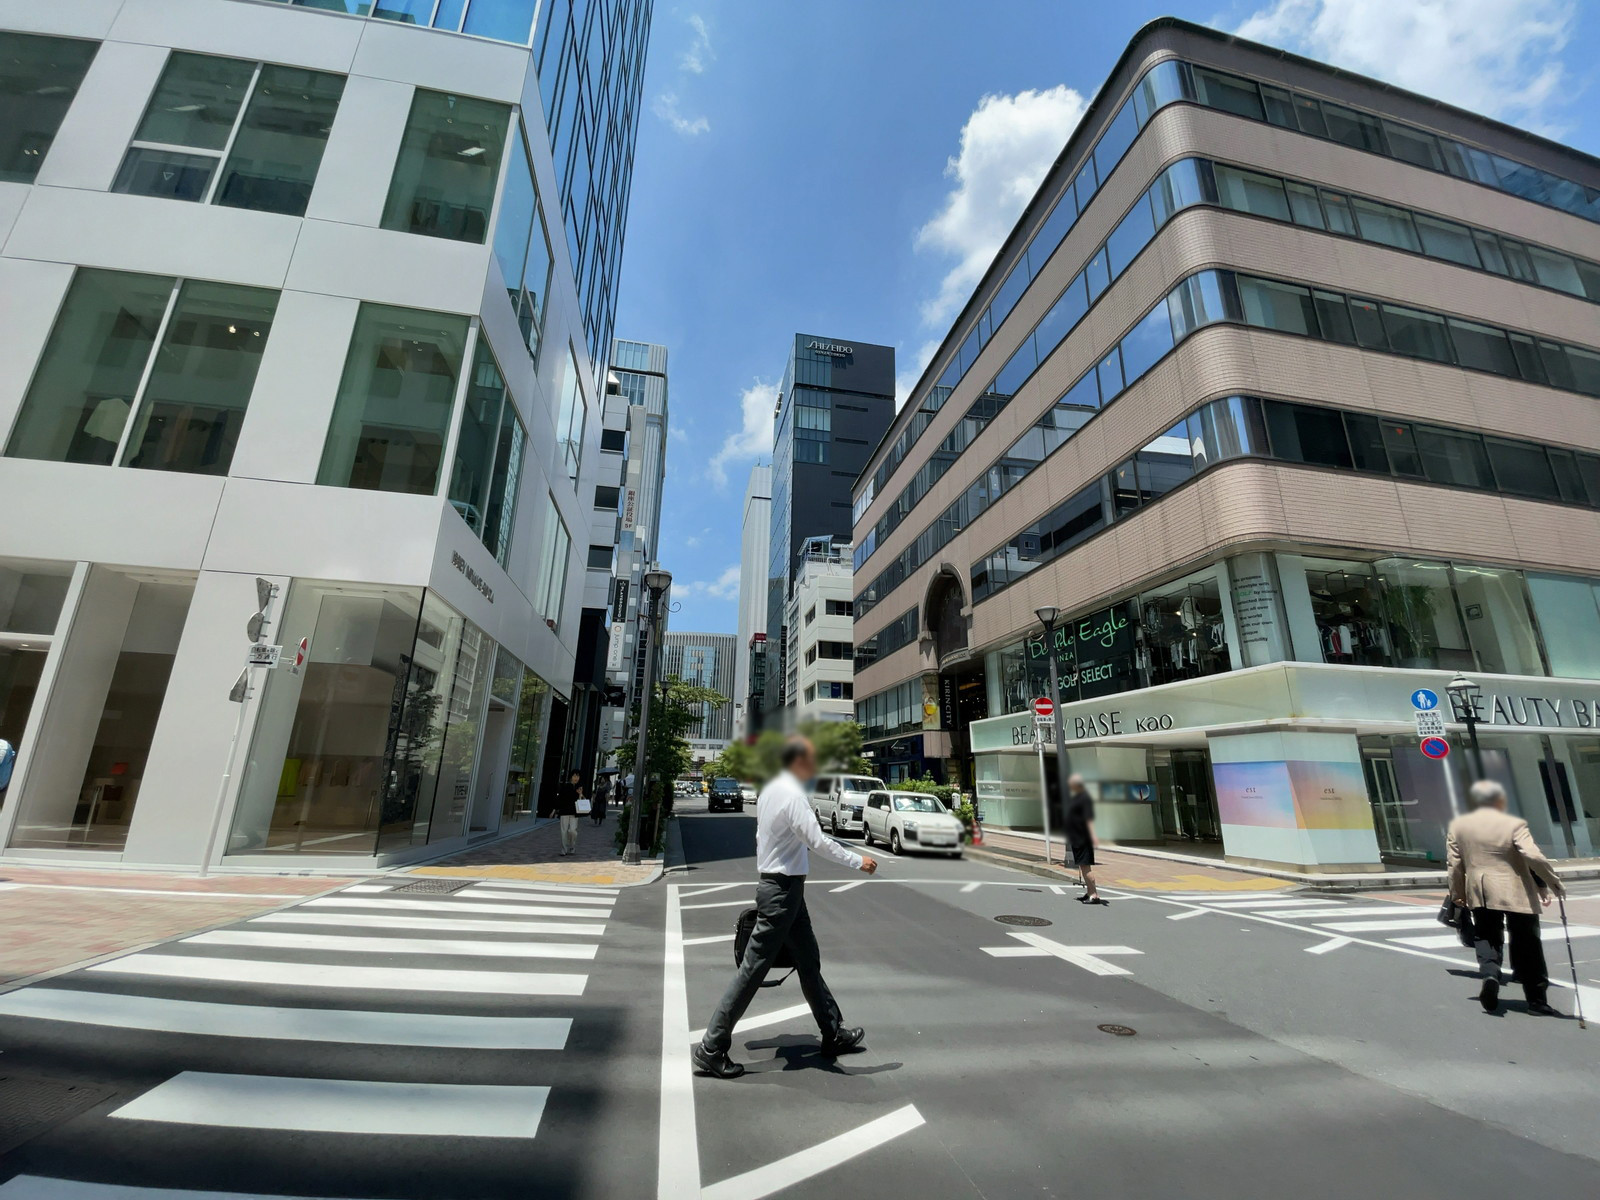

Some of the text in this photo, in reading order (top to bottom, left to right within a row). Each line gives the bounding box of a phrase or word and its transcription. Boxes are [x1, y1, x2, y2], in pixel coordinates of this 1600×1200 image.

[807, 341, 853, 354] SHISEIDO
[1030, 608, 1129, 658] Doble Eagle
[1056, 652, 1074, 662] INZA
[1081, 663, 1113, 684] SELECT
[1448, 694, 1561, 727] BEAUTY
[1012, 718, 1070, 746] BEAY
[1074, 711, 1124, 739] BASE
